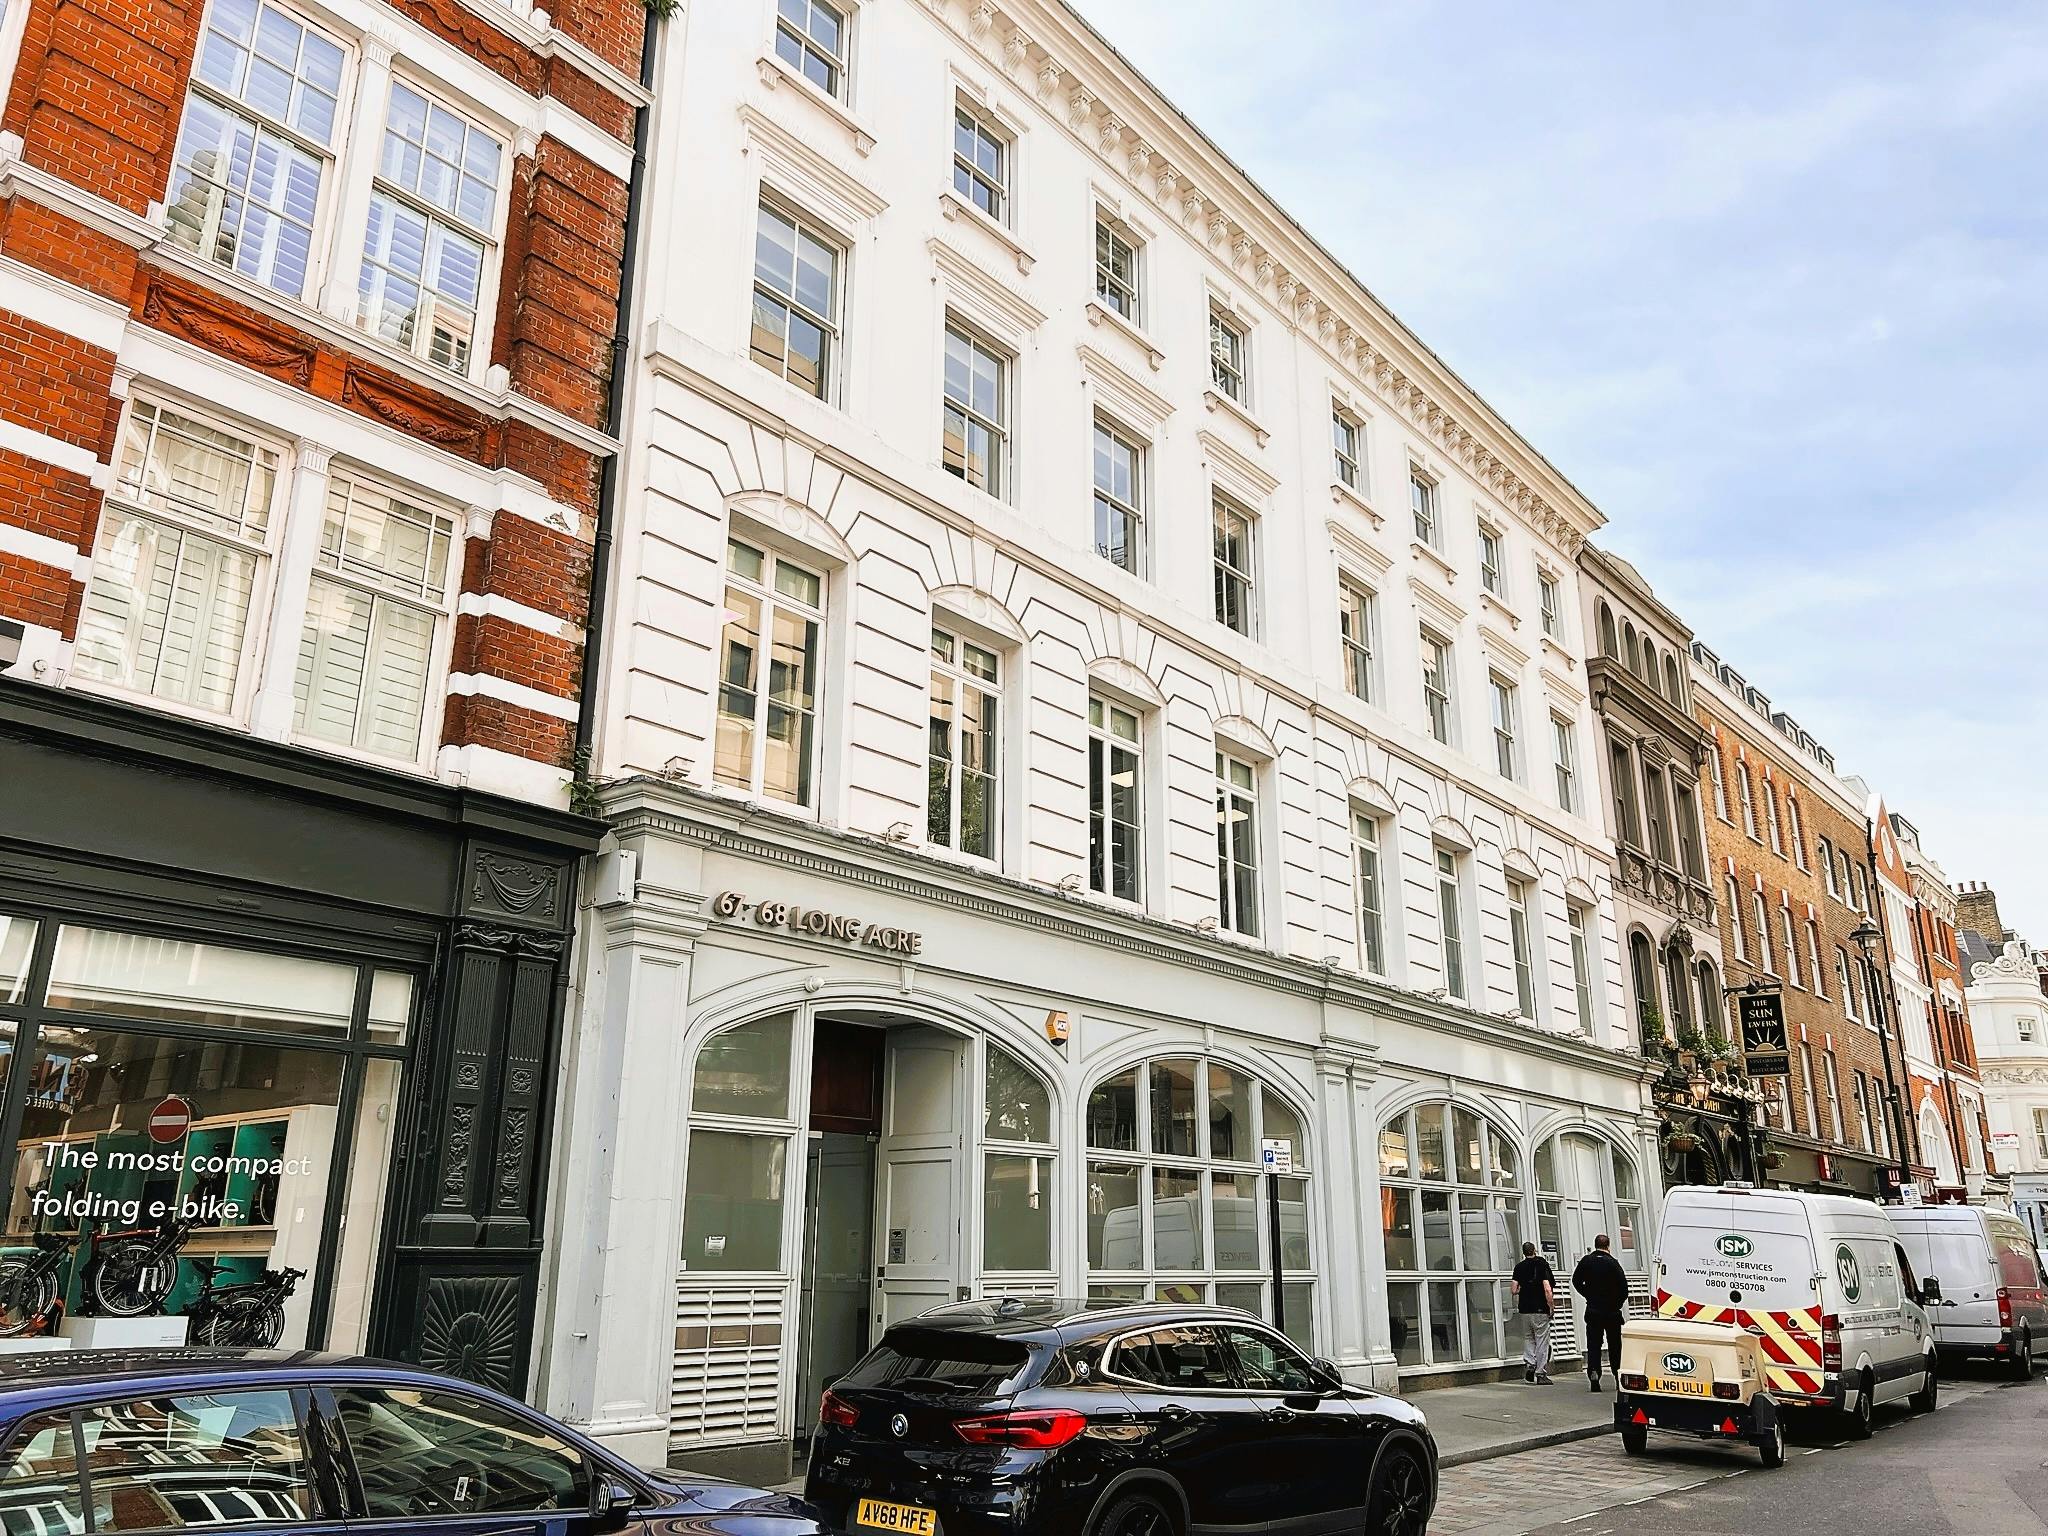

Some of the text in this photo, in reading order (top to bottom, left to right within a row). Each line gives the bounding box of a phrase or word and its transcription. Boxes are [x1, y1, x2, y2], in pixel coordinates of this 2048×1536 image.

[788, 905, 862, 942] LONG
[862, 923, 922, 955] ACRE
[1751, 999, 1768, 1007] THE
[1748, 1008, 1773, 1019] SUN
[1747, 1019, 1778, 1029] TAVERN
[41, 1142, 312, 1181] The most compact
[31, 1191, 247, 1225] folding e-bike.
[1719, 1239, 1749, 1255] JSM
[1735, 1261, 1773, 1272] SERVICES
[1685, 1267, 1788, 1284] www.jsmconstruction.com
[1837, 1257, 1859, 1293] JSM
[1705, 1279, 1766, 1293] 0800 0350708
[1664, 1356, 1692, 1371] JSM
[1655, 1379, 1704, 1394] LN61 ULU
[862, 1502, 930, 1532] AV68 HFE
